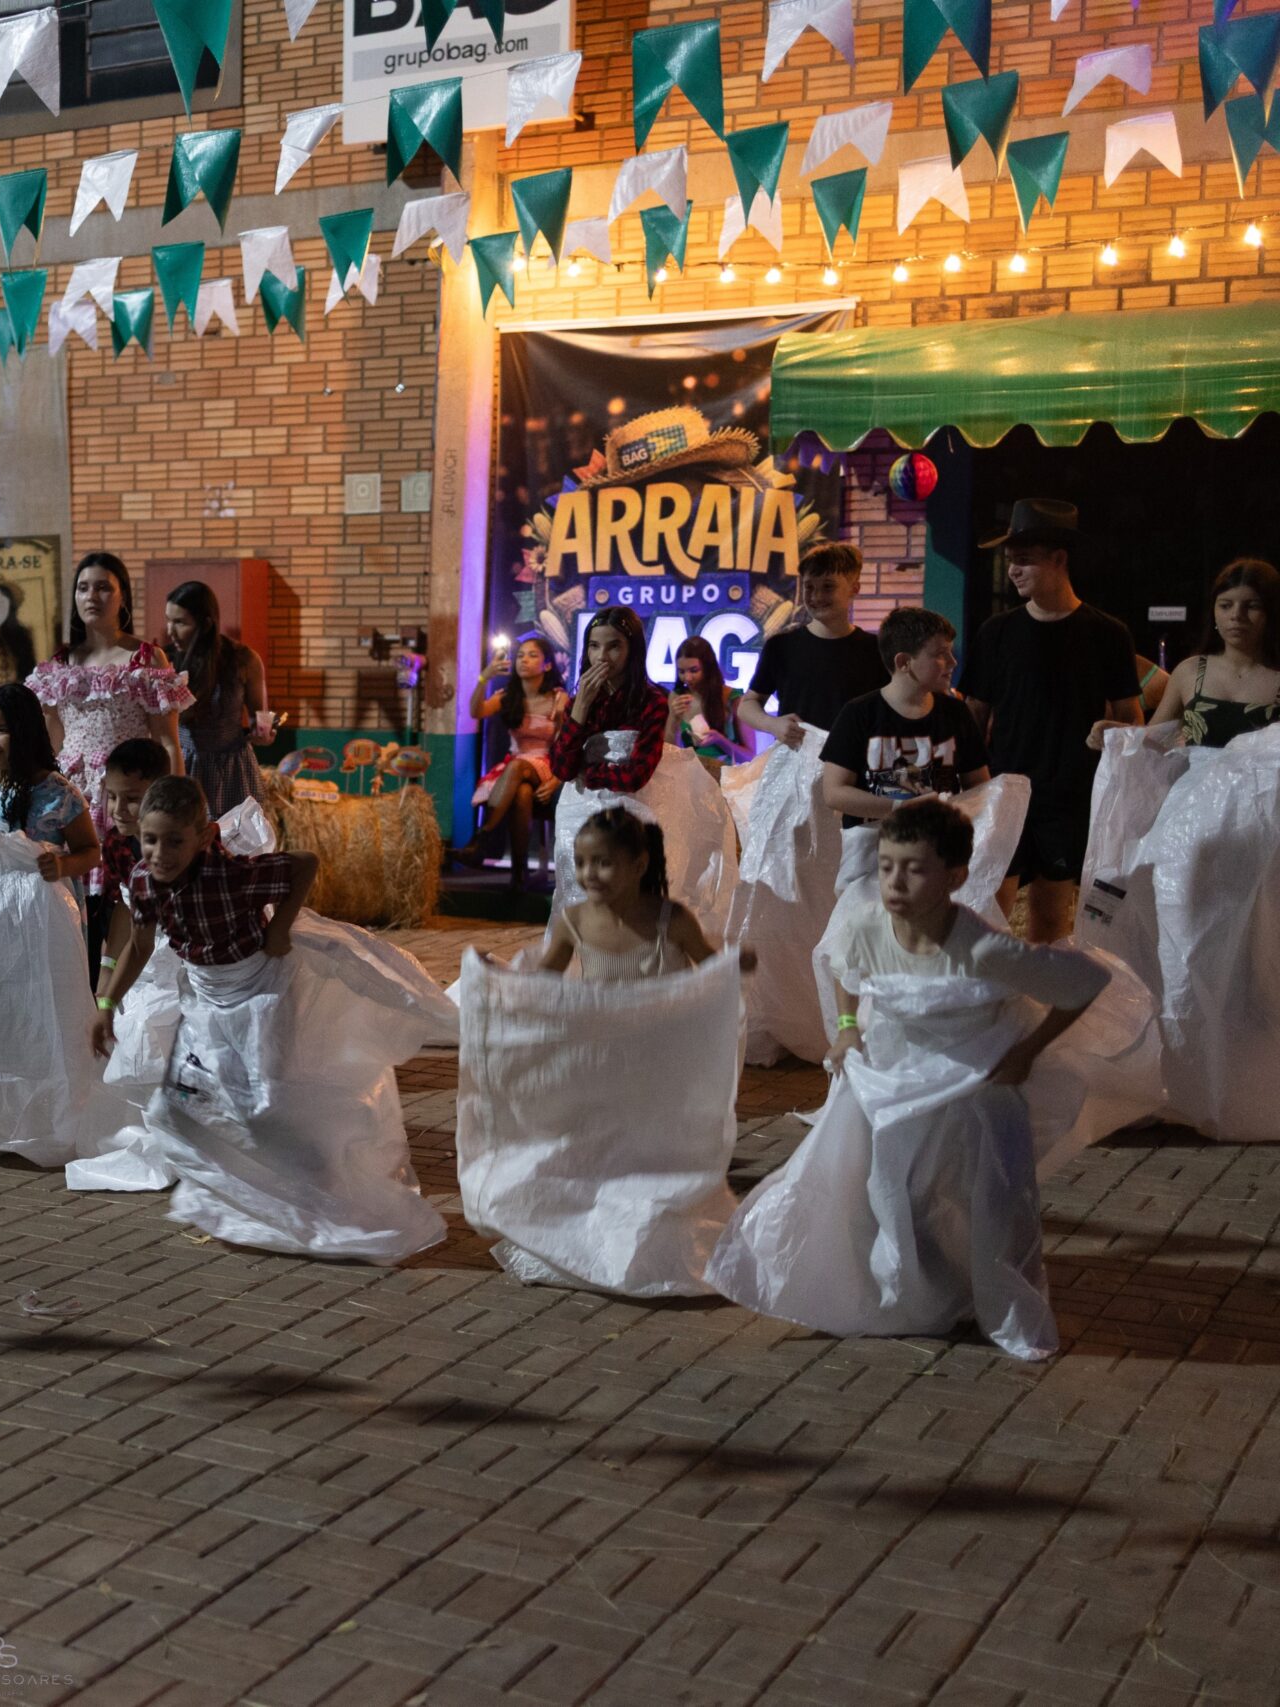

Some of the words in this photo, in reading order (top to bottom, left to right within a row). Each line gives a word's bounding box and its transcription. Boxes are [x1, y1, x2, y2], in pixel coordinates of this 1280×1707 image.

[384, 38, 528, 74] grupobag.com
[622, 448, 648, 466] BAG
[618, 584, 720, 605] GRUPO
[577, 612, 761, 695] AG
